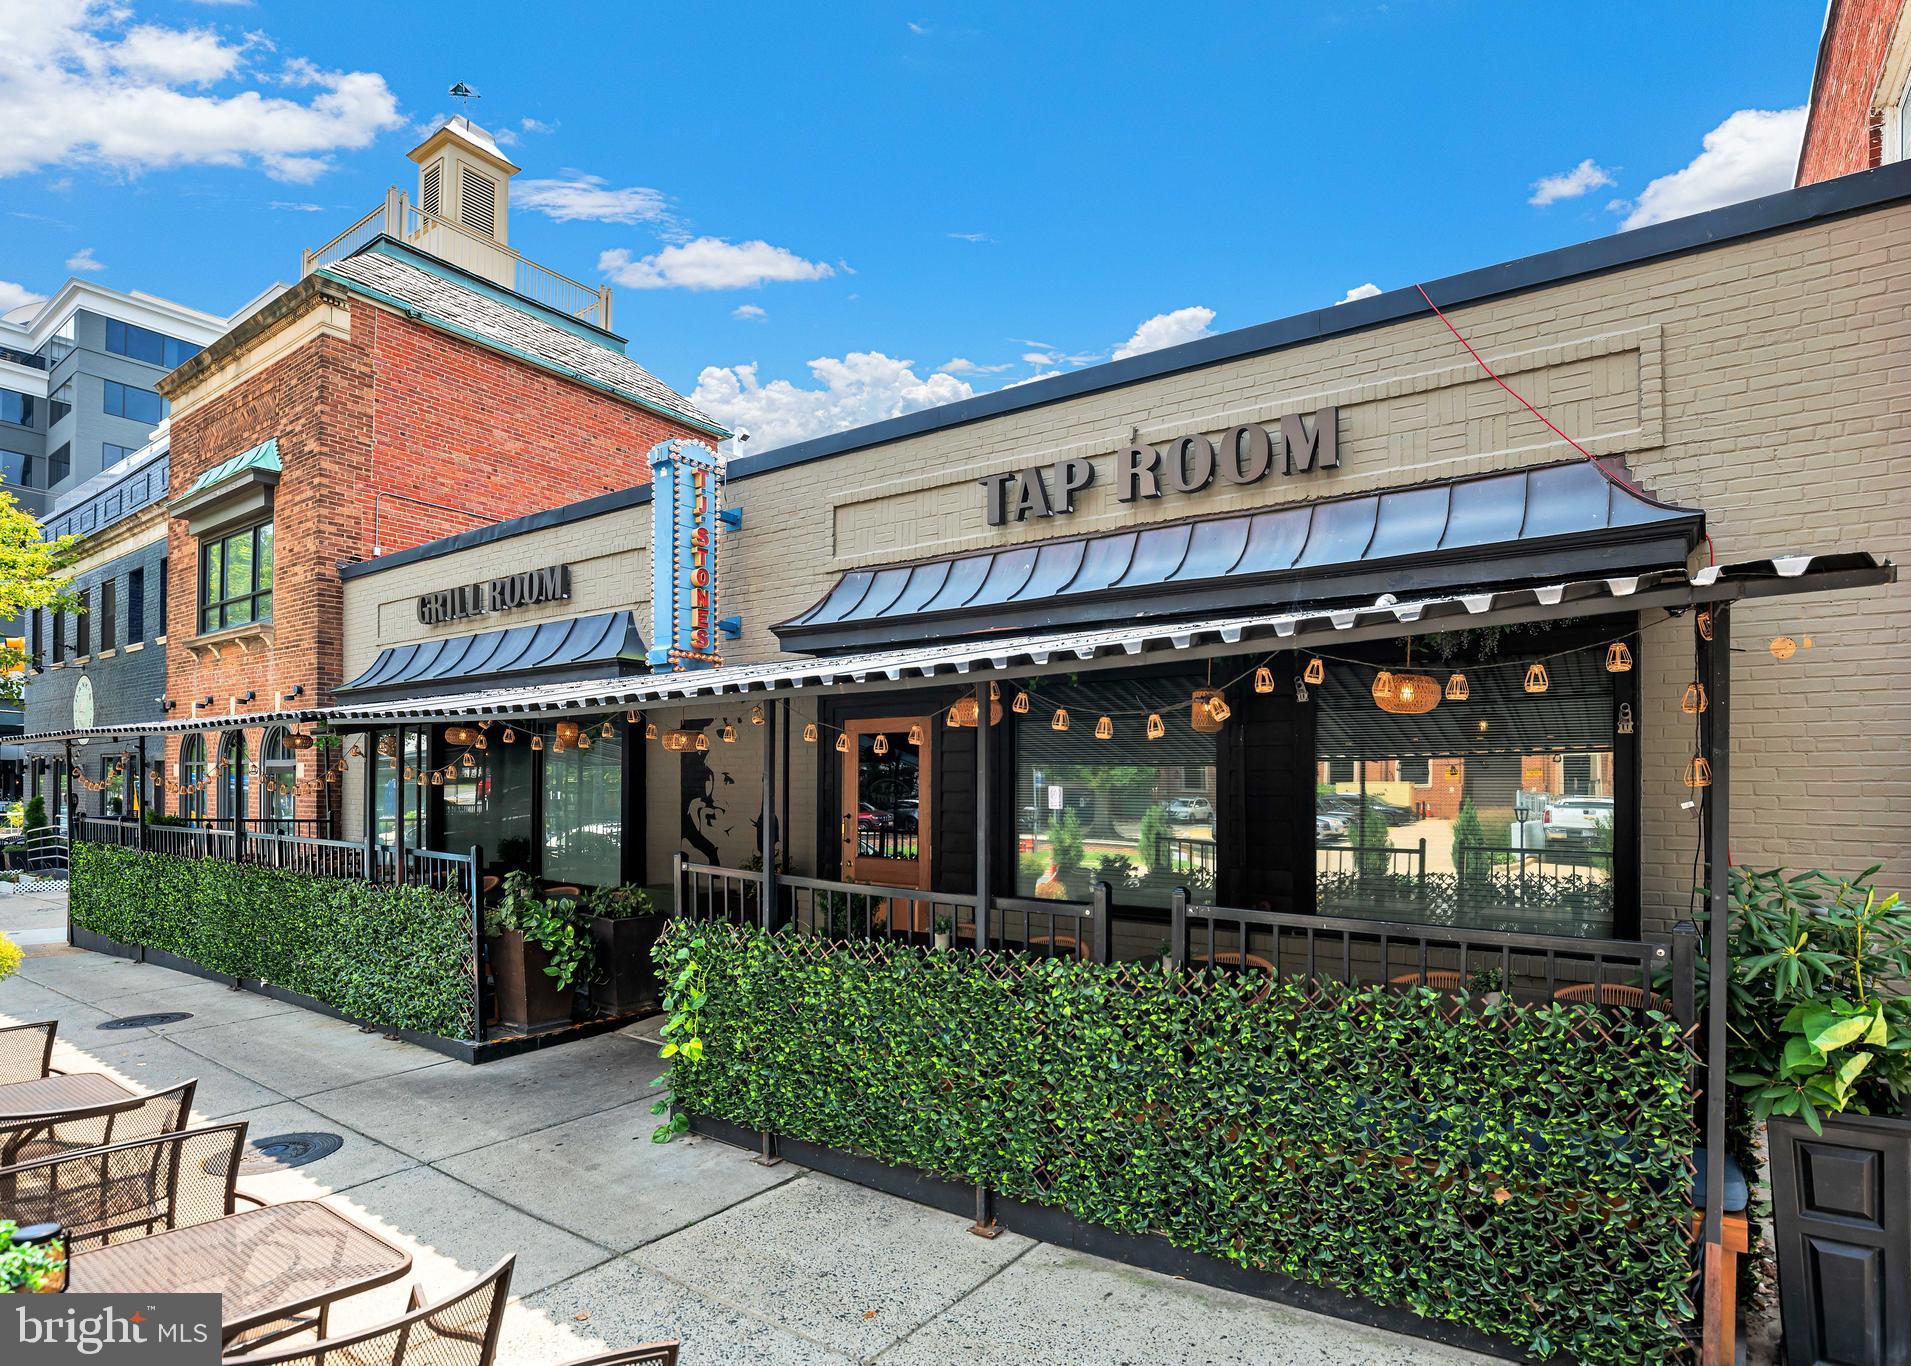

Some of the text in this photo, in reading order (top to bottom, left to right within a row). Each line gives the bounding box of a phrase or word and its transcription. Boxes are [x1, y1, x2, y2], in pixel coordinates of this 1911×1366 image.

[978, 405, 1340, 527] TAP ROOM
[416, 563, 570, 625] GRILL ROOM
[690, 527, 710, 649] STONES
